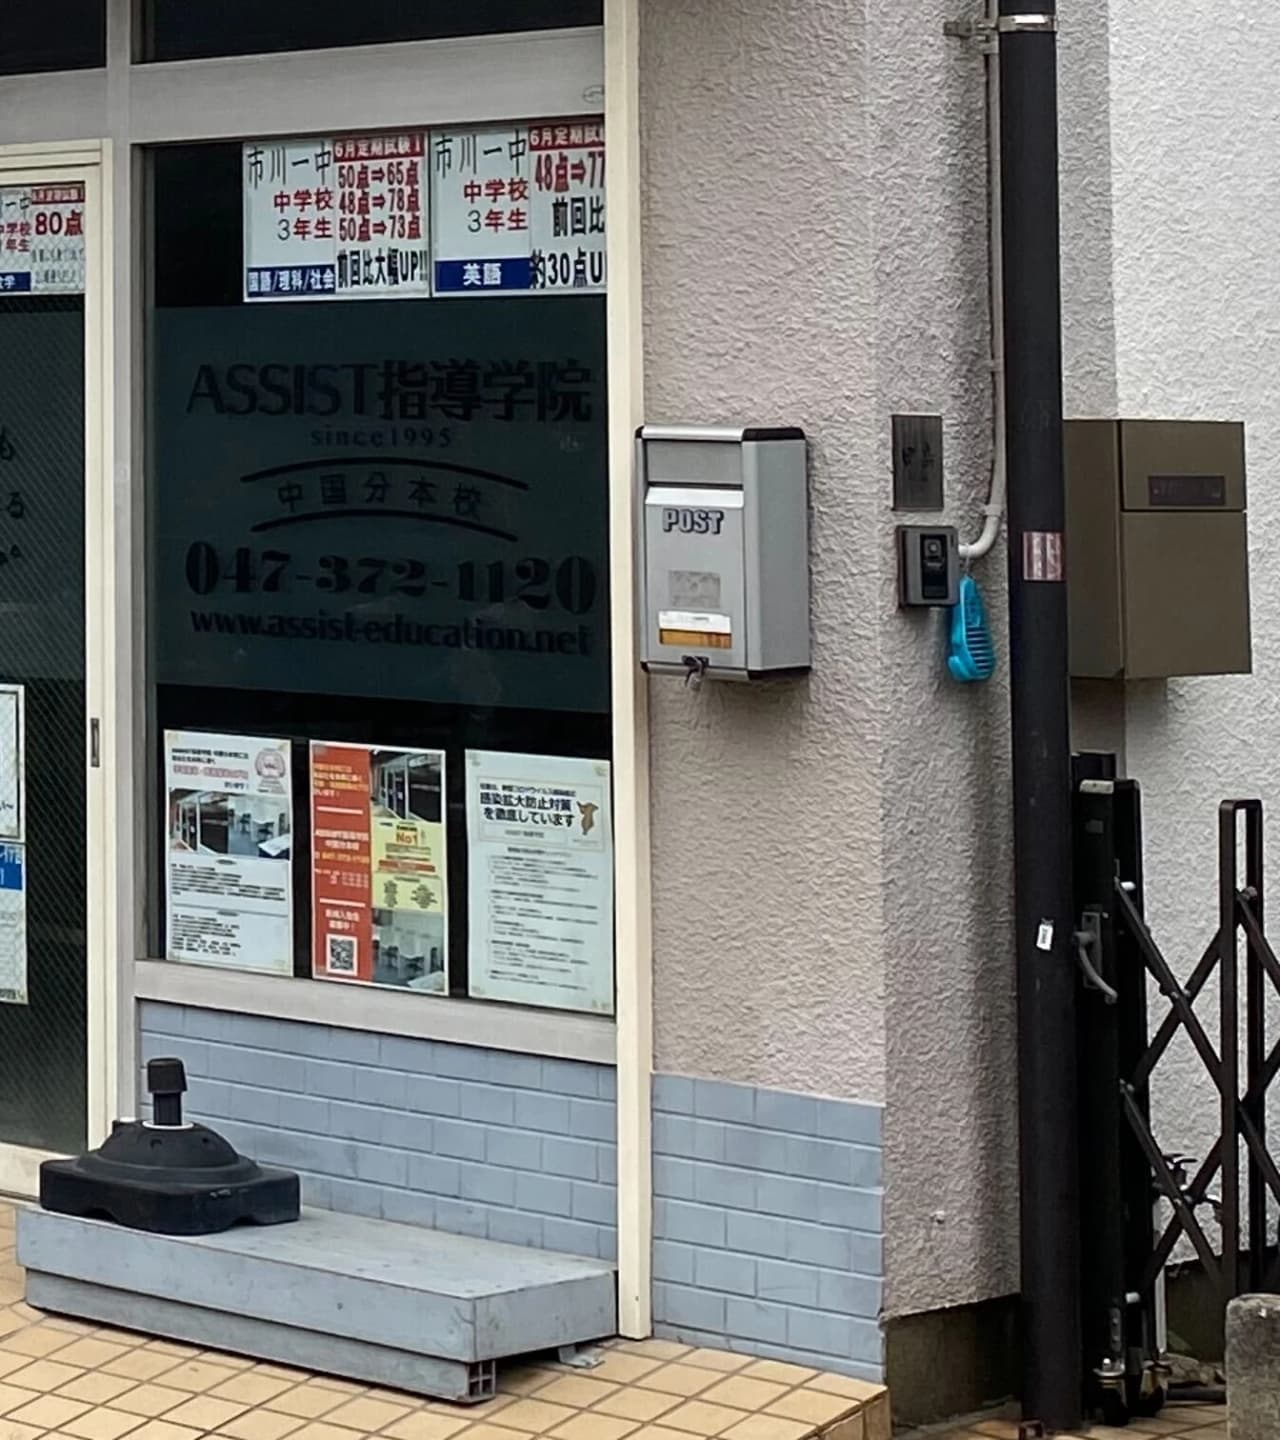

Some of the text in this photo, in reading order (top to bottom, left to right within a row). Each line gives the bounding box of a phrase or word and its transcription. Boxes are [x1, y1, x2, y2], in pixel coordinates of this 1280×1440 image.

[248, 141, 332, 189] 市川一中
[435, 128, 526, 178] 市川一中
[274, 189, 334, 213] 中学校
[464, 178, 528, 203] 中学校
[35, 210, 84, 236] 80点
[277, 216, 333, 241] 3年生
[468, 208, 528, 233] 3年生
[552, 196, 604, 238] 前回比
[463, 263, 501, 286] 英語
[186, 358, 593, 424] ASSIST指導学院
[276, 471, 483, 520] 中国分本校
[661, 507, 725, 535] POST
[185, 540, 597, 616] 047-372-1120
